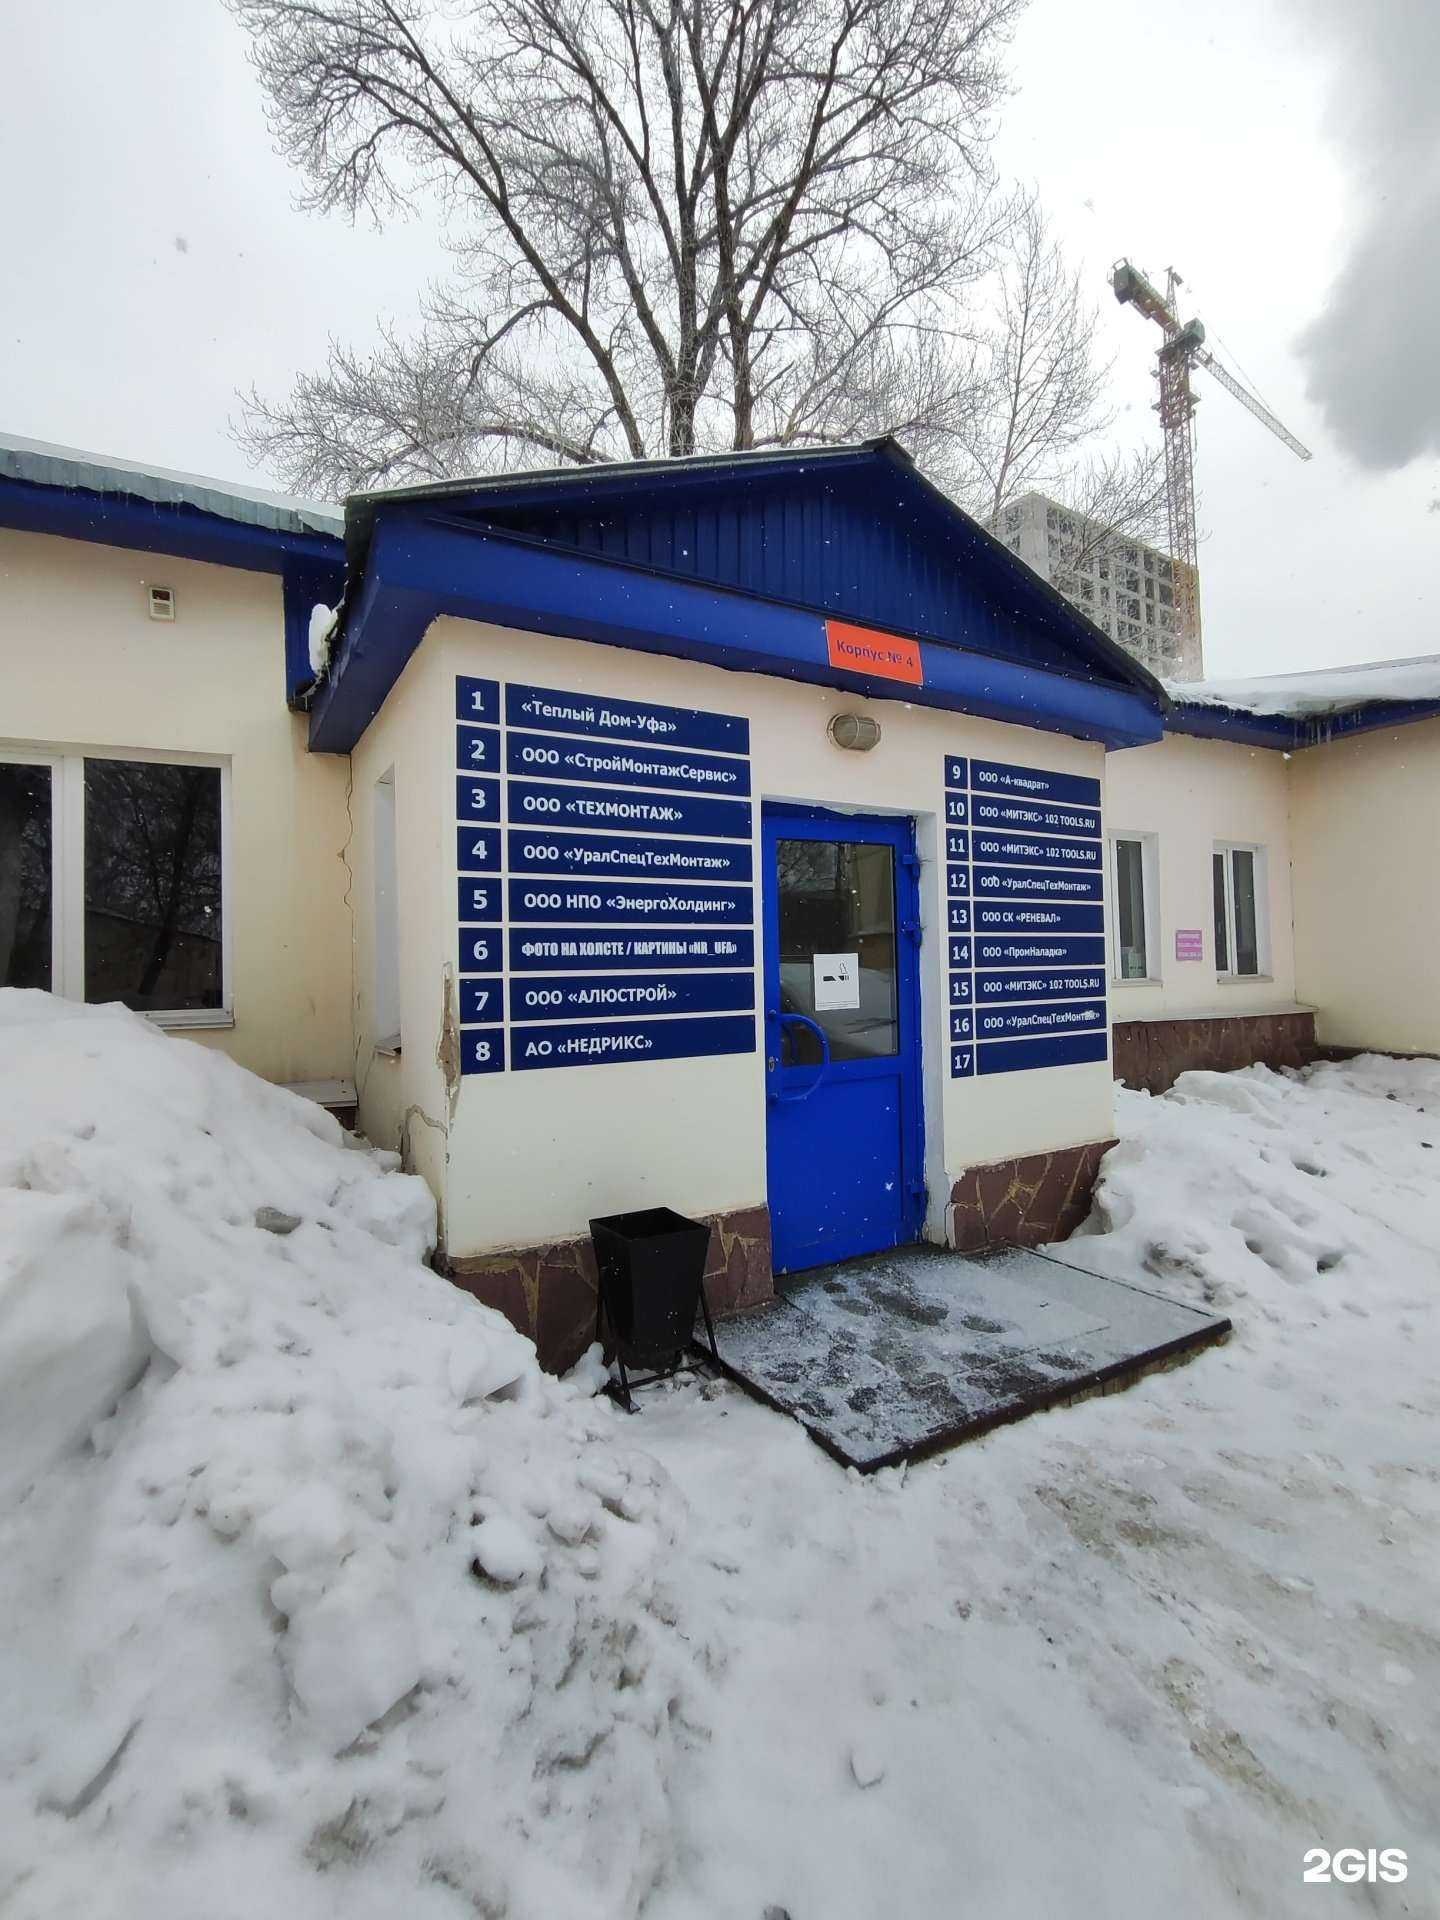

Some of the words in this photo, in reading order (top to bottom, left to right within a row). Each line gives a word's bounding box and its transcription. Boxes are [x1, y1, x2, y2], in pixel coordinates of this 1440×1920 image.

[836, 640, 884, 662] Корпус
[887, 651, 902, 664] №
[906, 656, 914, 667] 4
[471, 691, 485, 711] 1
[521, 700, 594, 722] «Теплый
[599, 710, 677, 733] Дом-Уфа»
[470, 740, 485, 760] 2
[522, 748, 559, 764] ООО
[564, 753, 737, 783] «СтройМонтажСервис»
[952, 765, 961, 780] 9
[979, 771, 998, 783] ООО
[1000, 775, 1050, 791] «А-квадрат»
[471, 789, 486, 808] 3
[523, 796, 561, 813] ООО
[565, 800, 683, 820] «ТЕХМОНТАЖ»
[949, 802, 965, 817] 10
[979, 806, 999, 818] ООО
[1001, 809, 1043, 823] «МИТЭКС»
[1045, 813, 1059, 825] 102
[1060, 816, 1096, 829] TOOLS.RU
[472, 840, 487, 859] 4
[523, 845, 559, 861] ООО
[563, 846, 730, 868] «УралСпецТехМонтаж»
[950, 838, 965, 853] 11
[980, 842, 999, 853] ООО
[1001, 844, 1044, 857] «МИТЭКС»
[1046, 847, 1060, 858] 102
[1061, 849, 1097, 861] TOOLS.RU
[950, 874, 967, 888] 12
[981, 876, 1000, 887] ООО
[1002, 878, 1092, 892] «УралСпецТехМонтаж»
[473, 889, 487, 909] 5
[524, 893, 561, 909] ООО
[566, 894, 601, 909] НПО
[606, 895, 736, 912] «ЭнергоХолдинг»
[952, 910, 967, 924] 13
[982, 912, 1001, 922] ООО
[1002, 912, 1014, 922] СК
[1015, 912, 1061, 923] «РЕНЕВАЛ»
[473, 940, 488, 960] 6
[521, 942, 558, 957] ФОТО
[562, 942, 578, 956] НА
[579, 942, 624, 956] ХОЛСТЕ
[626, 941, 631, 956] /
[633, 941, 687, 956] КАРТИНЫ
[952, 946, 968, 960] 14
[983, 947, 1001, 957] ООО
[1003, 946, 1067, 959] «ПромНаладка»
[475, 991, 489, 1011] 7
[525, 990, 562, 1005] ООО
[568, 983, 677, 1004] «АЛЮСТРОЙ»
[953, 982, 969, 997] 15
[983, 982, 1002, 992] ООО
[1004, 980, 1047, 991] «МИТЭКС»
[1049, 979, 1063, 990] 102
[1064, 977, 1100, 989] TOOLS.RU
[954, 1018, 970, 1033] 16
[984, 1017, 1004, 1029] ООО
[475, 1041, 490, 1061] 8
[525, 1040, 551, 1057] АО
[557, 1034, 653, 1054] «НЕДРИКС»
[954, 1054, 971, 1070] 17
